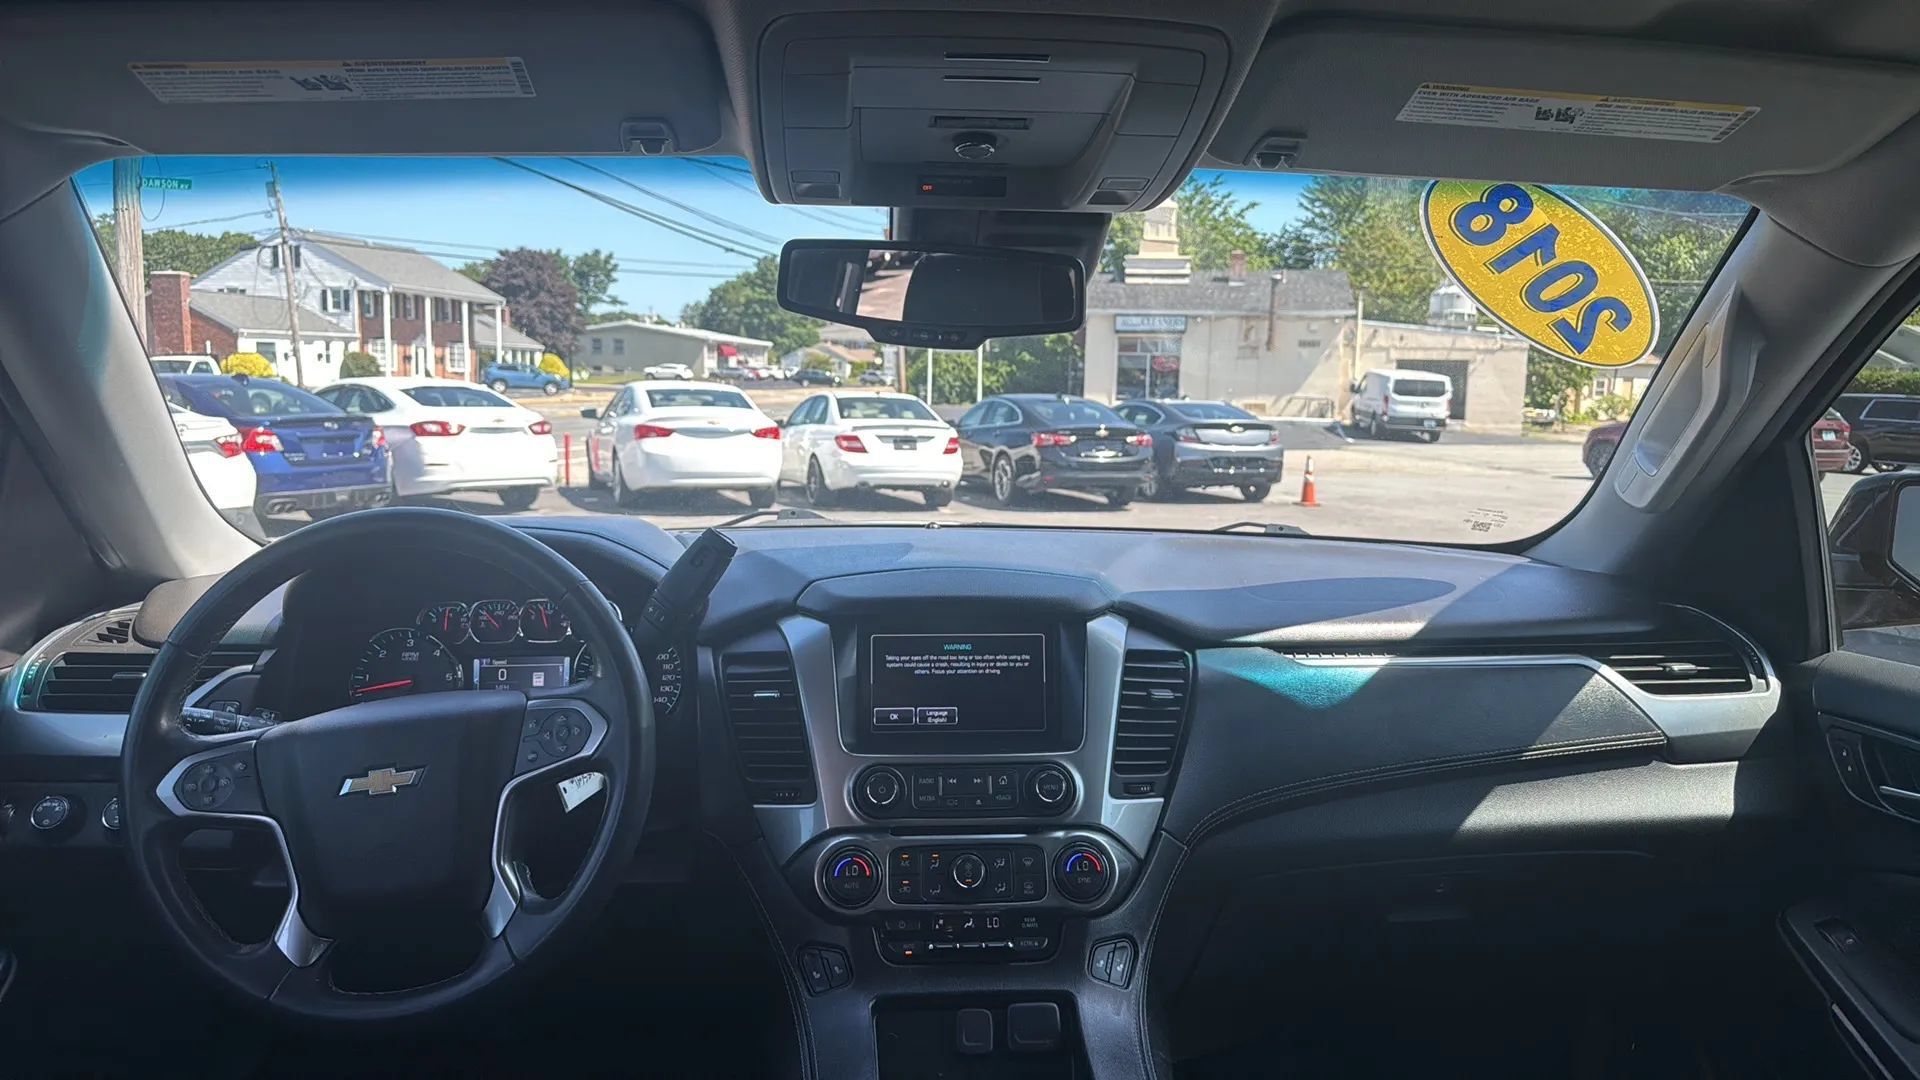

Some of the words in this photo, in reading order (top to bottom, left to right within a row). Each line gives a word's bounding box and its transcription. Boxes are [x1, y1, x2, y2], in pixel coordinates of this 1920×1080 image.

[142, 178, 179, 190] DAWSON
[406, 639, 414, 647] 3
[943, 643, 973, 651] WARNING
[379, 649, 387, 658] 2
[433, 649, 441, 657] 4
[885, 654, 900, 662] Taking
[662, 663, 674, 671] 110
[445, 673, 453, 681] 5
[498, 668, 507, 681] 0
[662, 674, 675, 682] 120
[889, 713, 899, 721] OK
[918, 777, 935, 785] RADIO
[986, 917, 1000, 929] LO
